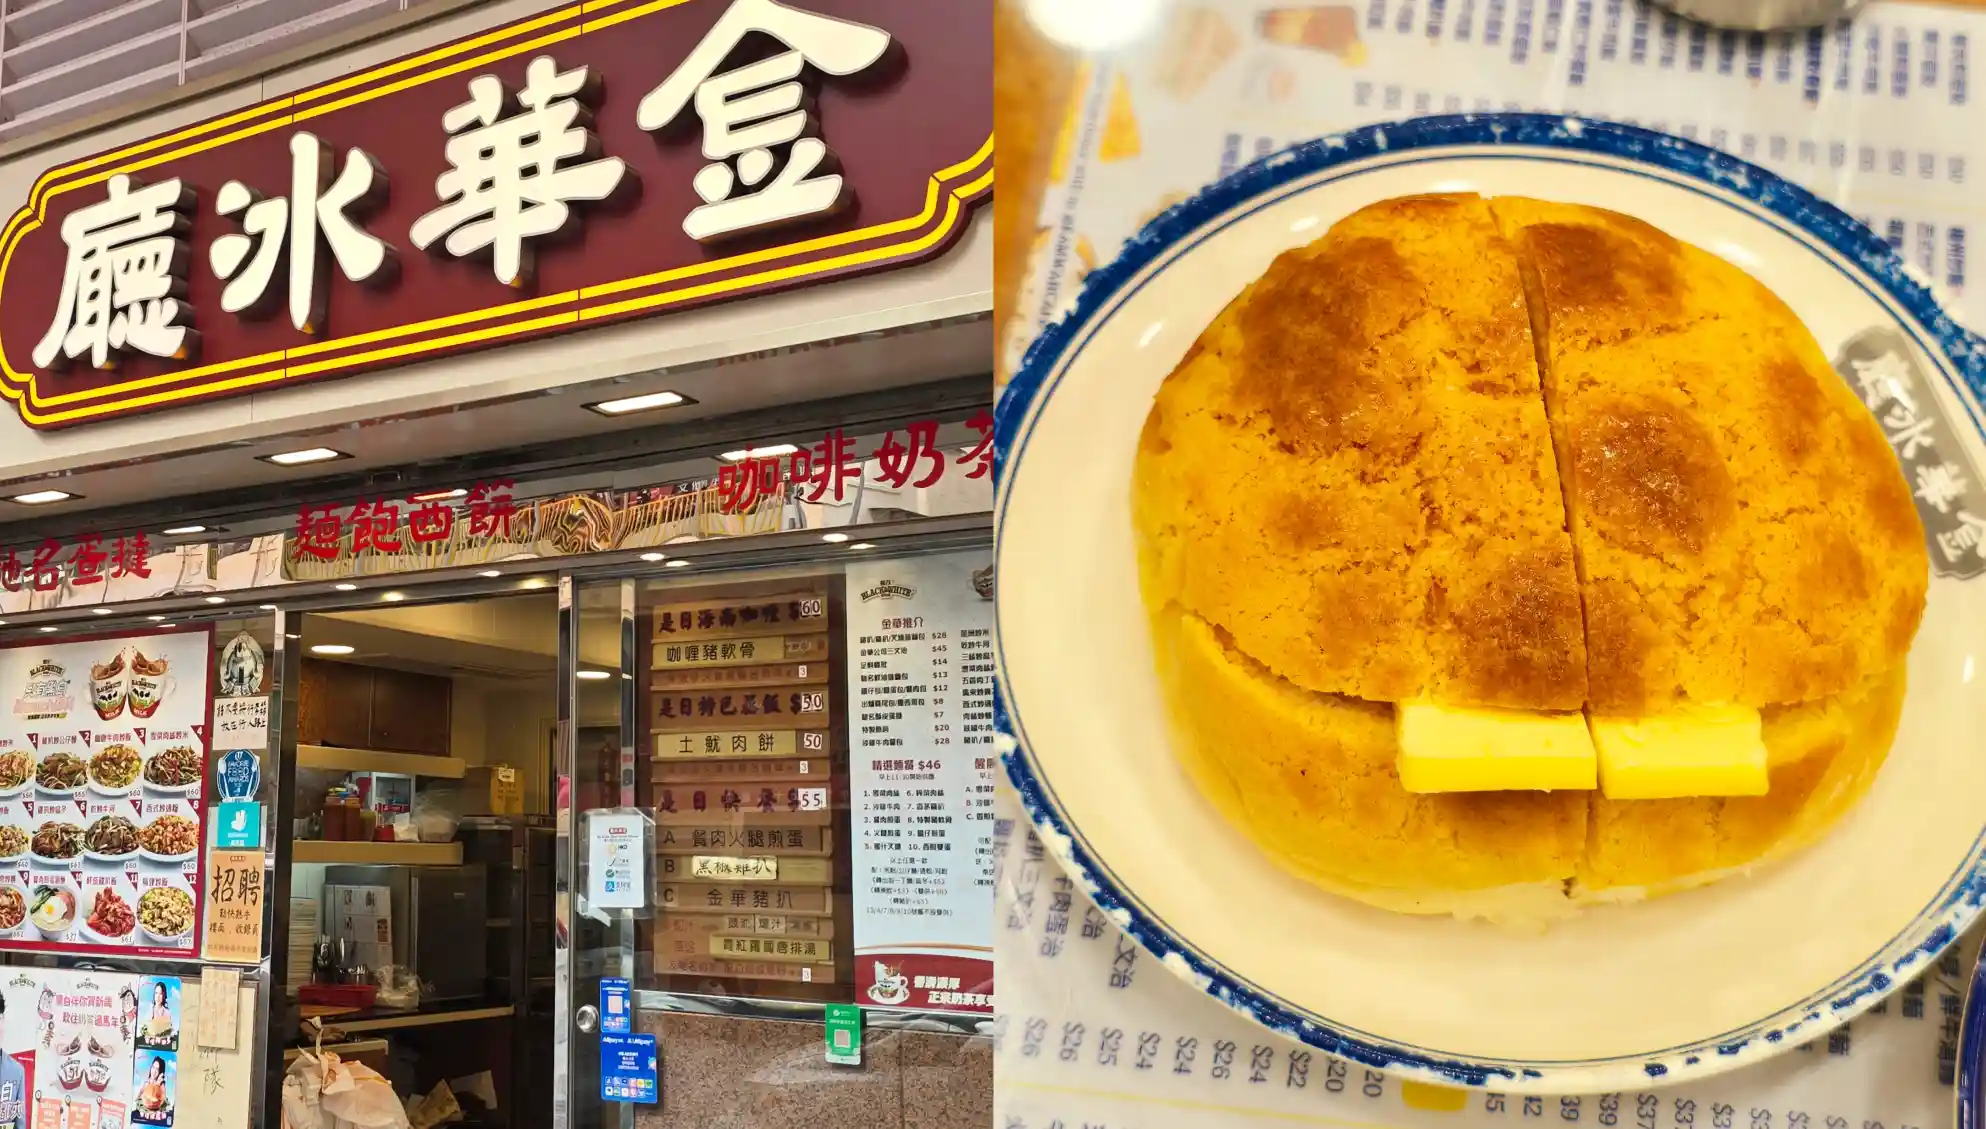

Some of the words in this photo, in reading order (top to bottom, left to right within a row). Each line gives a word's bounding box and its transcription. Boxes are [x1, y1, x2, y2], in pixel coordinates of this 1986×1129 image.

[294, 480, 518, 563] 麵飽西餅
[932, 632, 947, 640] $28
[667, 641, 755, 662] 咖喱豬軟骨
[932, 645, 947, 653] $45
[932, 658, 947, 666] $14
[196, 726, 202, 736] 4
[934, 724, 949, 732] $20
[32, 734, 37, 743] 1
[84, 732, 90, 741] 2
[139, 729, 145, 739] 3
[679, 733, 774, 754] 土魷肉餅
[804, 734, 822, 748] 50
[934, 738, 950, 746] $28
[918, 760, 941, 771] $46
[28, 803, 33, 811] 5
[80, 802, 86, 811] 6
[136, 801, 141, 810] 7
[193, 799, 199, 809] 8
[664, 831, 676, 845] A
[692, 829, 803, 848] 餐肉火腿煎蛋
[665, 859, 675, 872] B
[23, 871, 28, 881] 9
[75, 872, 82, 882] 10
[131, 873, 139, 883] 11
[189, 875, 197, 884] 12
[211, 864, 260, 906] 招聘
[663, 888, 675, 903] C
[708, 889, 792, 909] 金華豬扒
[1060, 1022, 1086, 1062] $26
[1099, 1026, 1123, 1067] $25
[1136, 1031, 1162, 1070] $24
[1173, 1035, 1198, 1075] $24
[1211, 1039, 1237, 1080] $26
[1249, 1044, 1274, 1084] $24
[1286, 1050, 1313, 1090] $22
